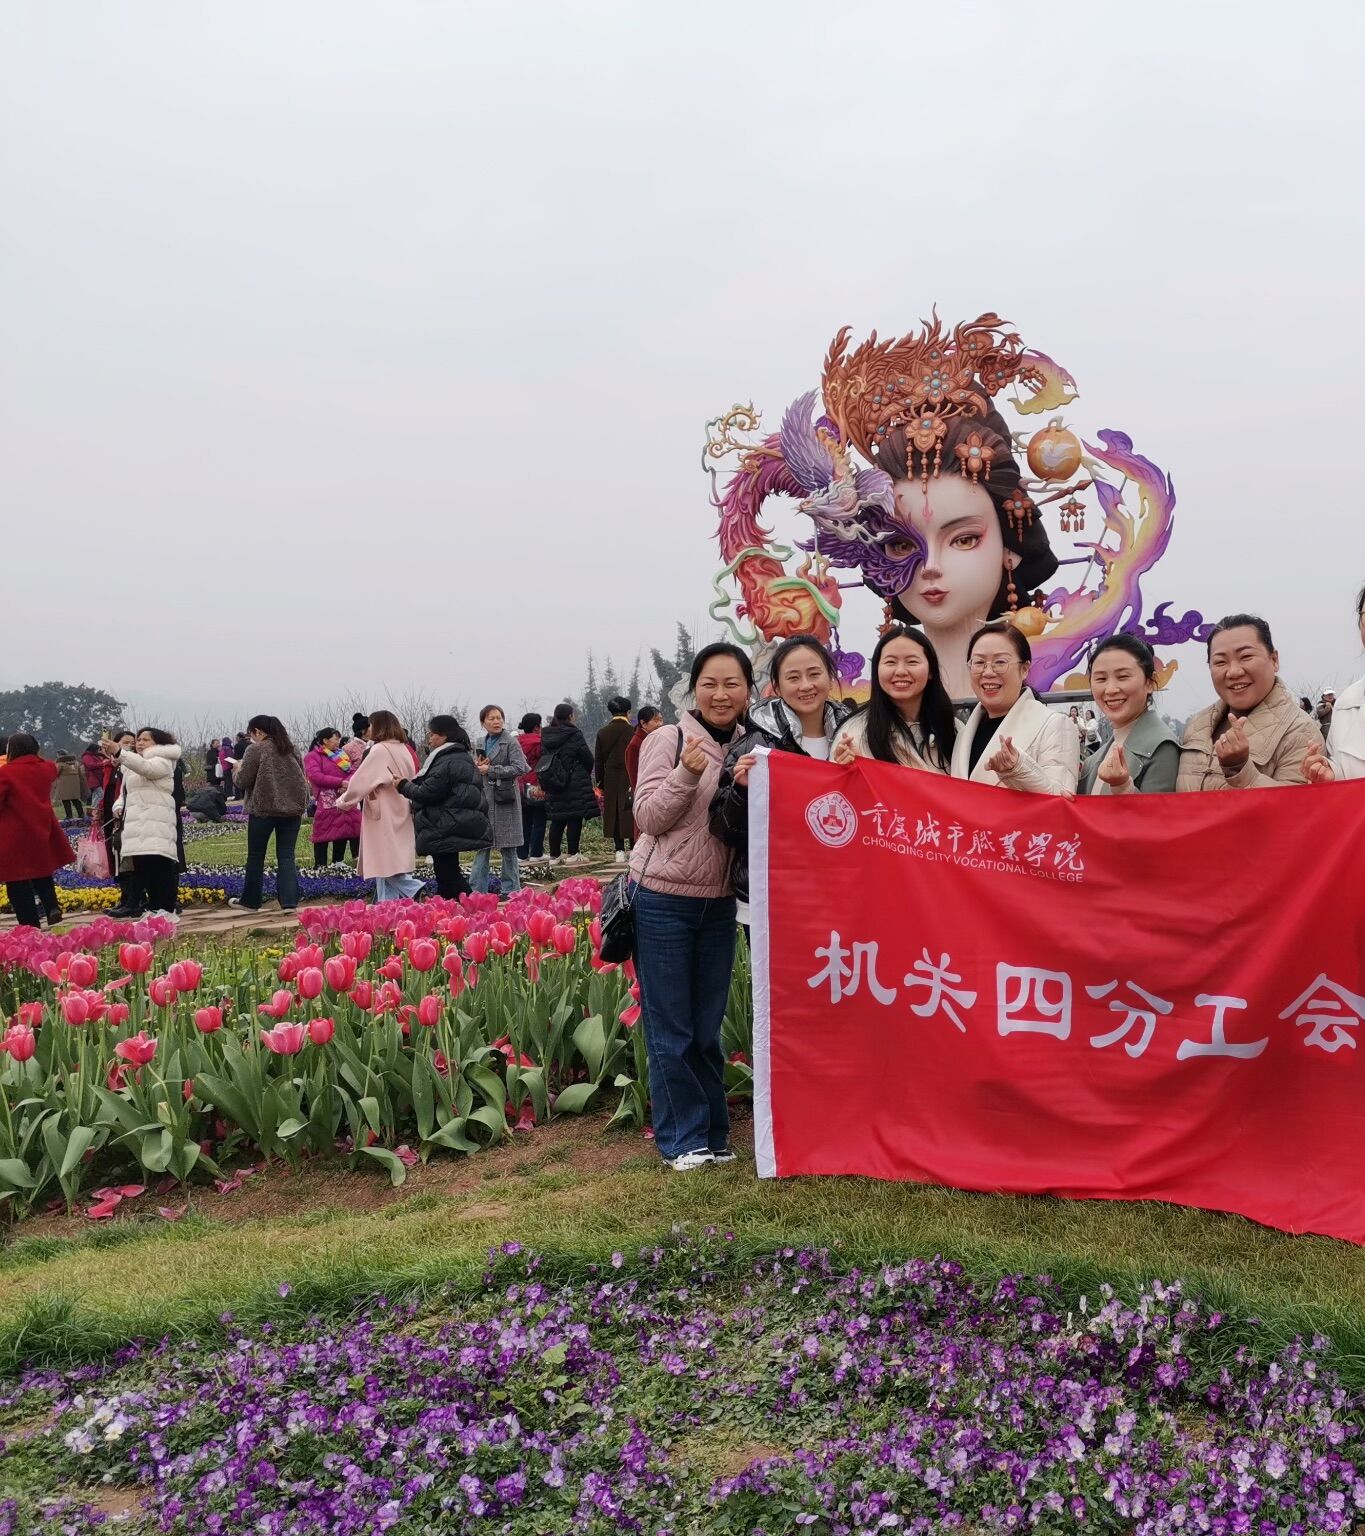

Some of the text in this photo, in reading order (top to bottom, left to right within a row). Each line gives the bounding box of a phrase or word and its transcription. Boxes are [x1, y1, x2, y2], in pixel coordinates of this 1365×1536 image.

[862, 836, 1084, 882] CHONGQING CITY VOCATIONAL COLLEGE
